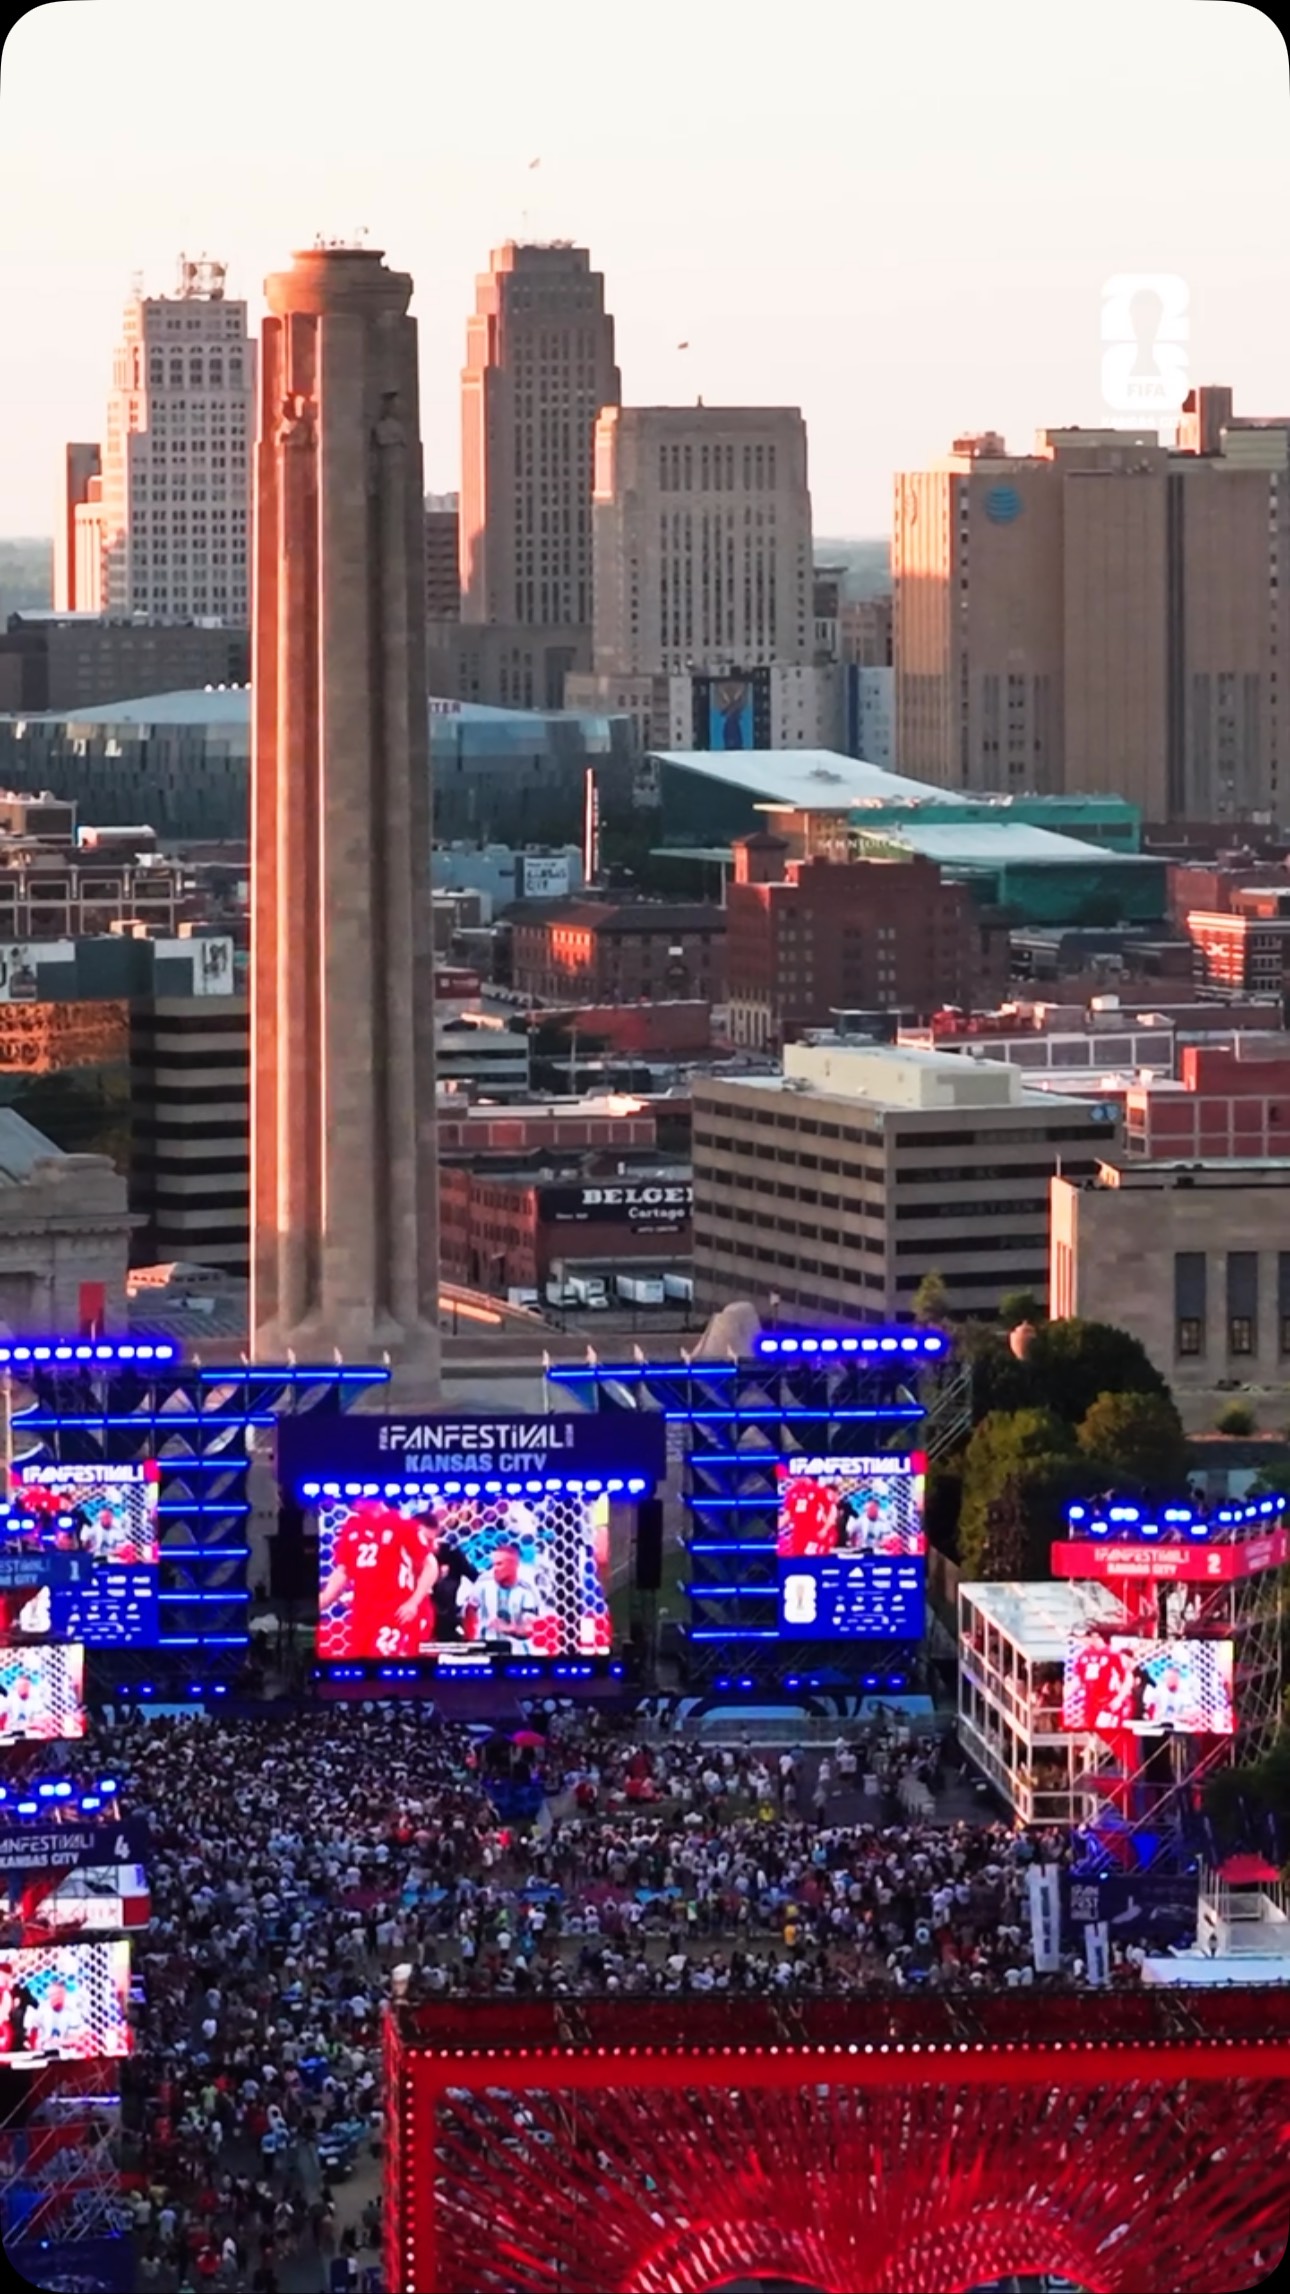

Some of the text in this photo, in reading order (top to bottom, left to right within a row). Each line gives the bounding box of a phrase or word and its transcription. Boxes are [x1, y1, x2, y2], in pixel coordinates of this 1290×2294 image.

[628, 1207, 685, 1221] Cartage
[405, 1453, 547, 1472] KANSAS CITY
[356, 1542, 378, 1568] 22
[1207, 1552, 1221, 1575] 2
[70, 1560, 80, 1582] 1
[376, 1626, 400, 1652] 22
[114, 1834, 130, 1859] 4
[51, 1852, 79, 1866] CITY
